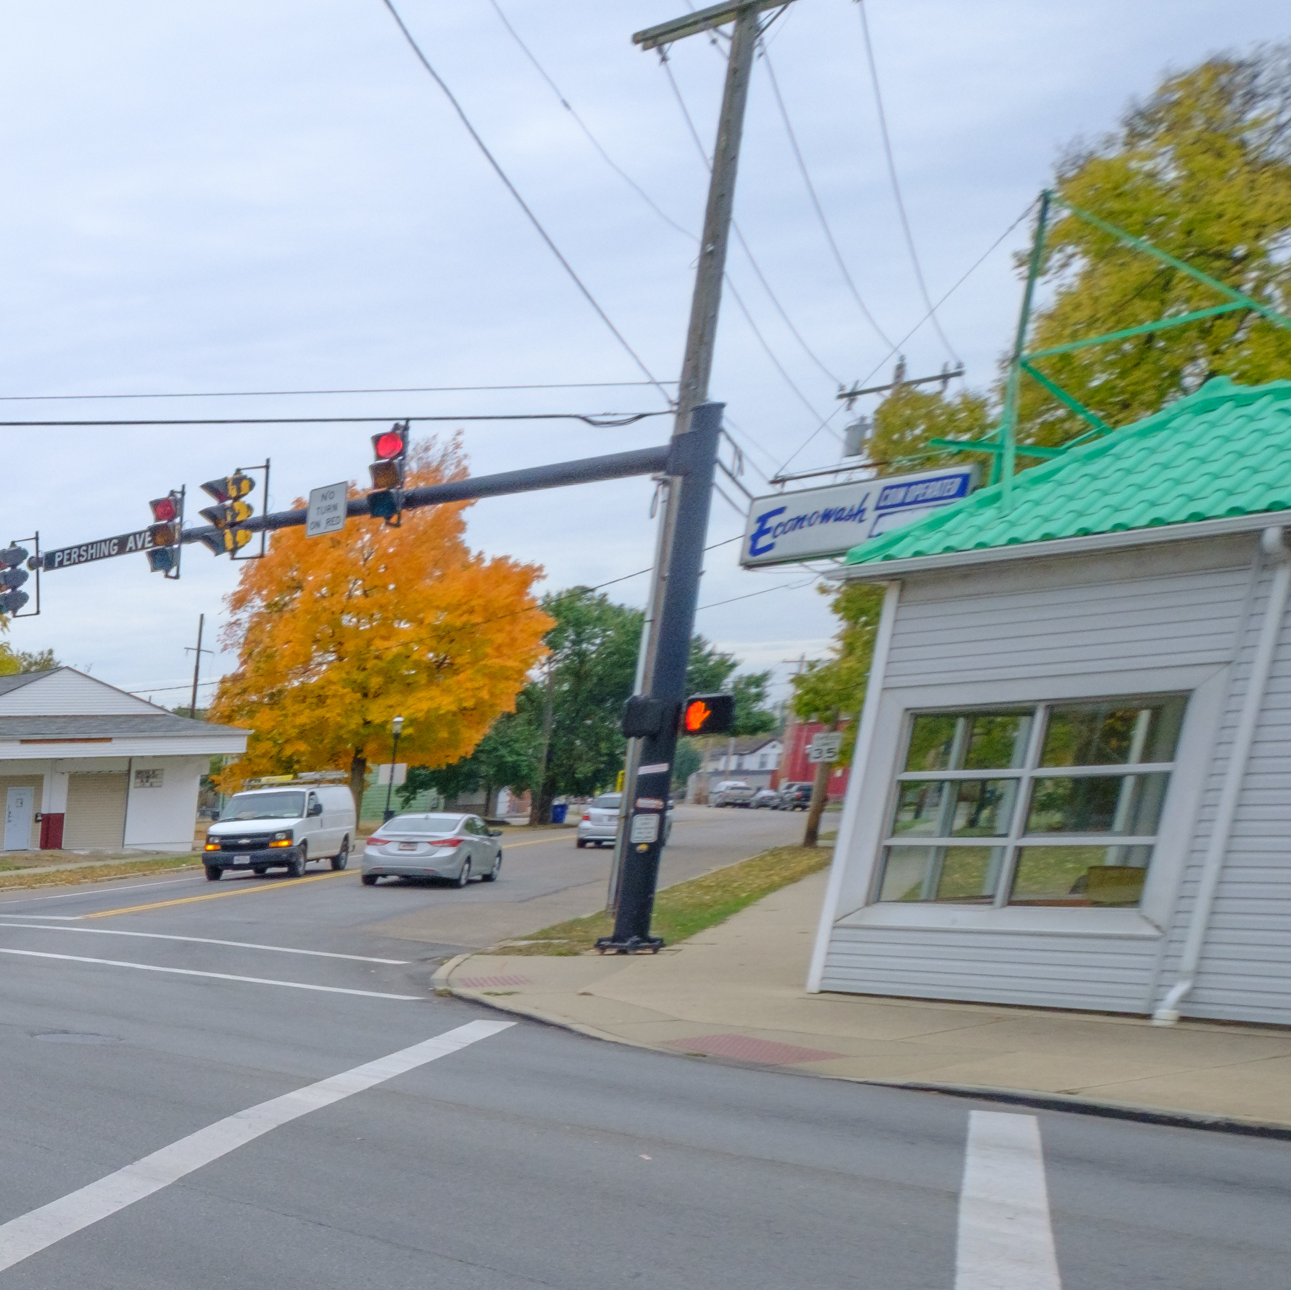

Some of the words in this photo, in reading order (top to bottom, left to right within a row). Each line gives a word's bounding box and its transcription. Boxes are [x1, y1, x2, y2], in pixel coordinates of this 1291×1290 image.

[321, 490, 335, 501] NO
[905, 478, 962, 503] OPERATED
[316, 503, 339, 515] TURN
[309, 520, 321, 530] ON
[324, 515, 341, 529] RED
[749, 492, 871, 557] Econowash
[54, 539, 119, 568] PERSHING
[125, 531, 154, 552] AVE
[812, 747, 838, 759] 35
